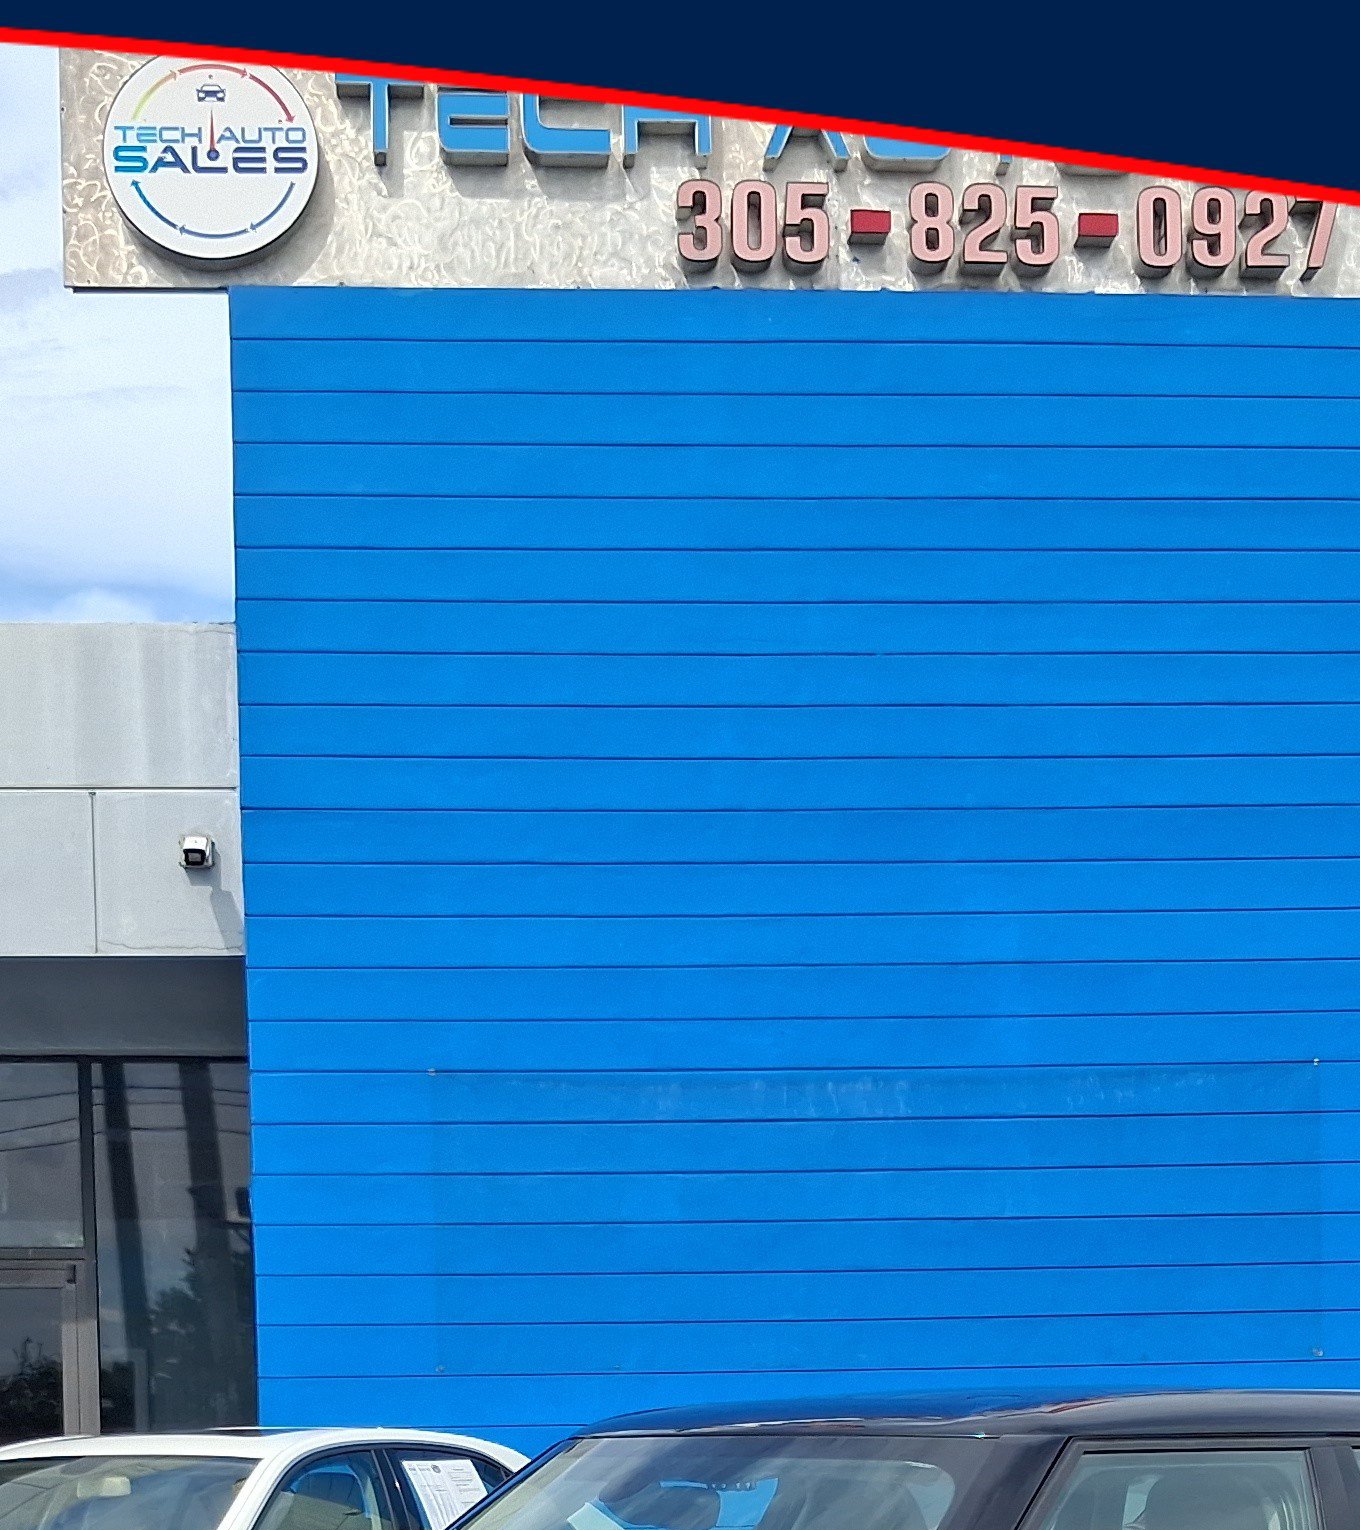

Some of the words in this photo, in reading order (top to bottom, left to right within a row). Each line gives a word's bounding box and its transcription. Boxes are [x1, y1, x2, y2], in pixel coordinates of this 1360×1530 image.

[113, 124, 204, 145] TECH
[216, 125, 307, 145] AUTO
[112, 145, 308, 175] SALES
[677, 179, 1339, 272] 305-825-0927
